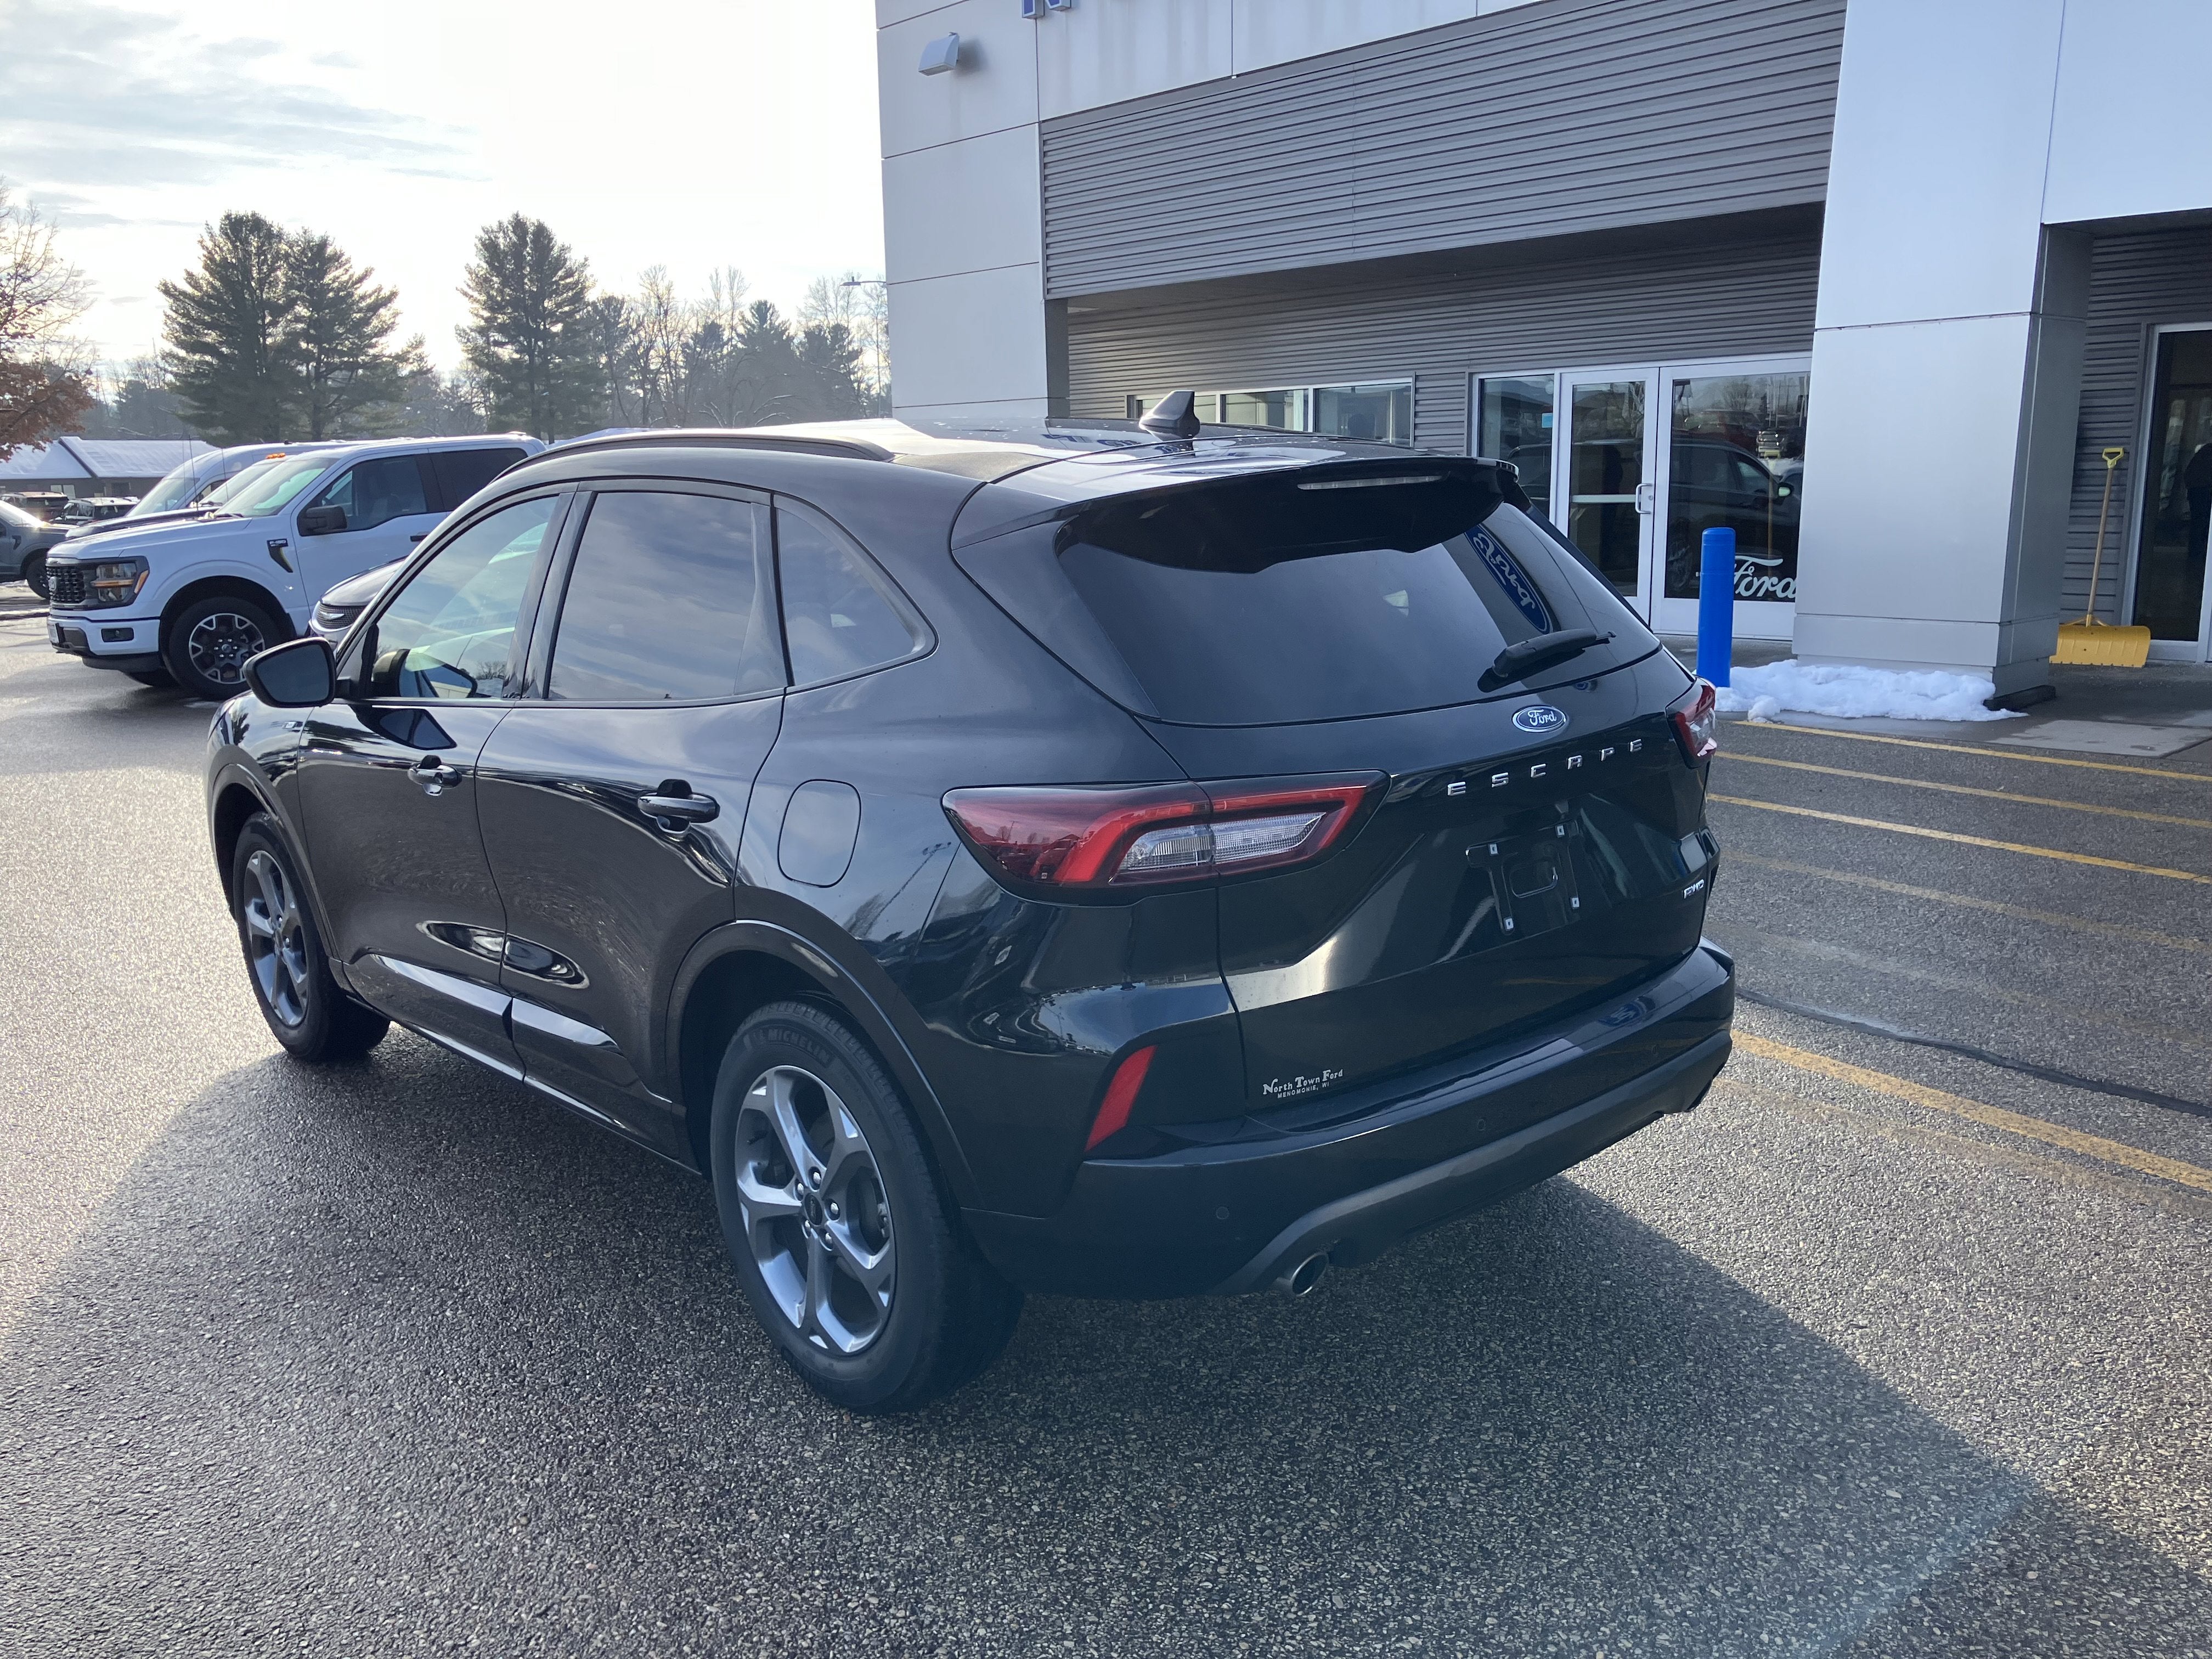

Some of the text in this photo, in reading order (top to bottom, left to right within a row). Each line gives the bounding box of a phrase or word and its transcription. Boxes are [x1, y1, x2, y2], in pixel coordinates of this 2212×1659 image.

[1527, 709, 1557, 726] Ford
[1447, 738, 1643, 797] ESCAPE
[768, 1029, 830, 1064] MICHELIN
[1263, 1069, 1343, 1094] North Town Ford
[1277, 1085, 1319, 1099] MENOMONIE,
